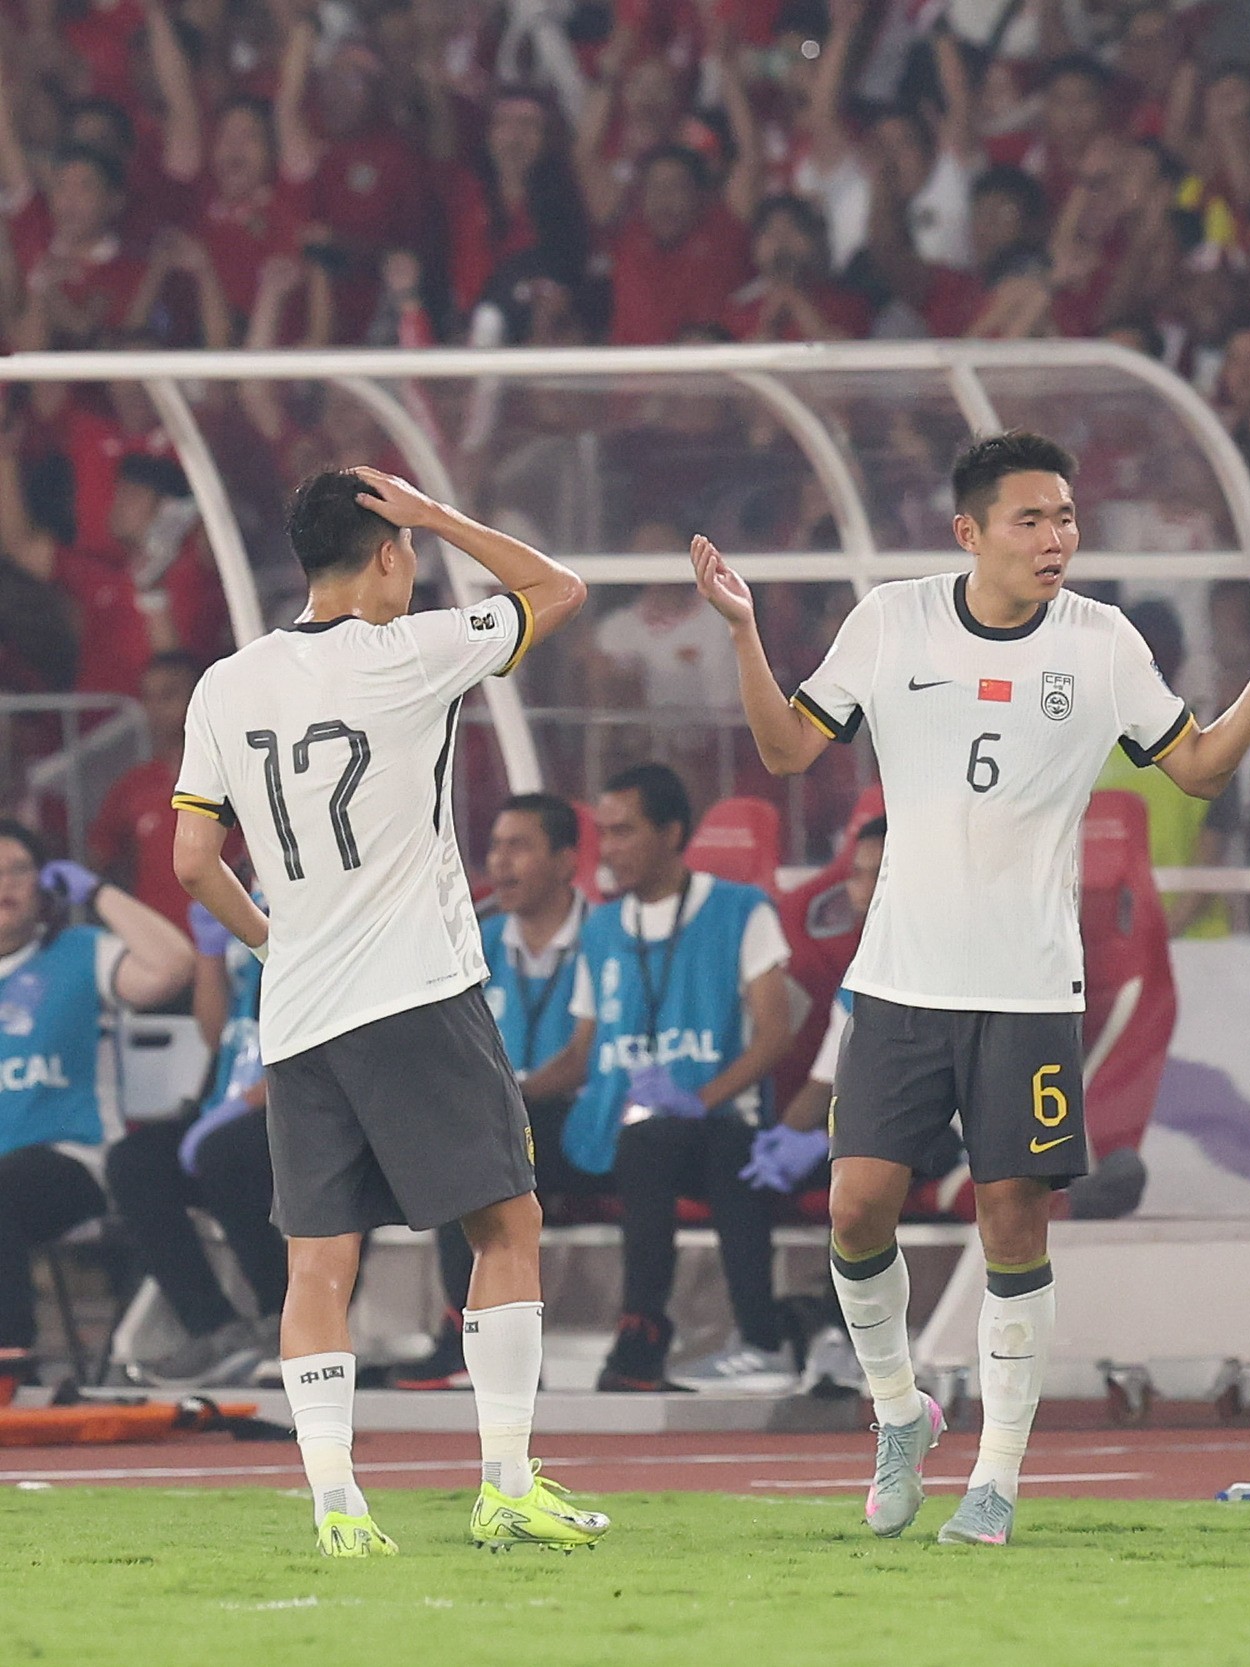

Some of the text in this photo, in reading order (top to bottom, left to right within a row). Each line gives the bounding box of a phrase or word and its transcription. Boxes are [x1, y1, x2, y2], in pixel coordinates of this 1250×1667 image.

[966, 732, 1001, 793] 6
[246, 719, 371, 881] 17
[0, 1053, 69, 1092] CAL
[1033, 1065, 1067, 1127] 6
[300, 1365, 345, 1384] 中国
